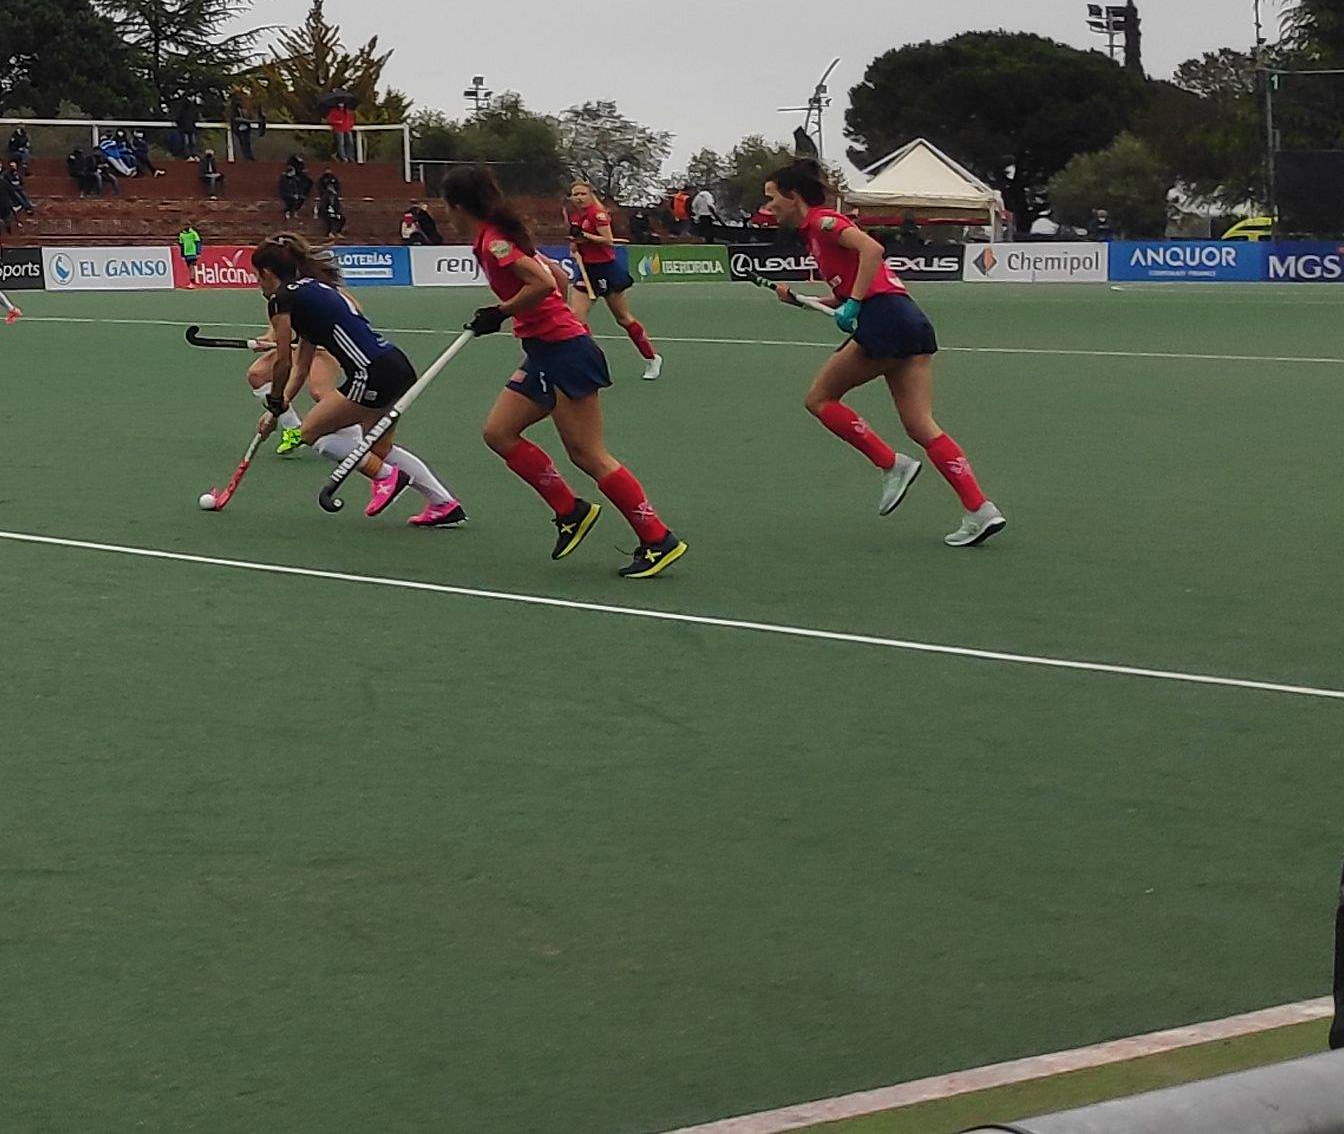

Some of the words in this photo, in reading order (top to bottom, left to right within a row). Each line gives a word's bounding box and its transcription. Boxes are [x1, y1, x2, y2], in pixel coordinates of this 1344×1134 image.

[753, 256, 819, 272] LEXUS
[885, 256, 960, 272] EXUS
[1007, 251, 1100, 275] Chemipol
[1129, 246, 1237, 267] ANQUOR
[79, 260, 101, 278] EL
[105, 259, 168, 277] GANSO
[662, 259, 725, 275] IBERDROLA
[1268, 254, 1342, 279] MGS
